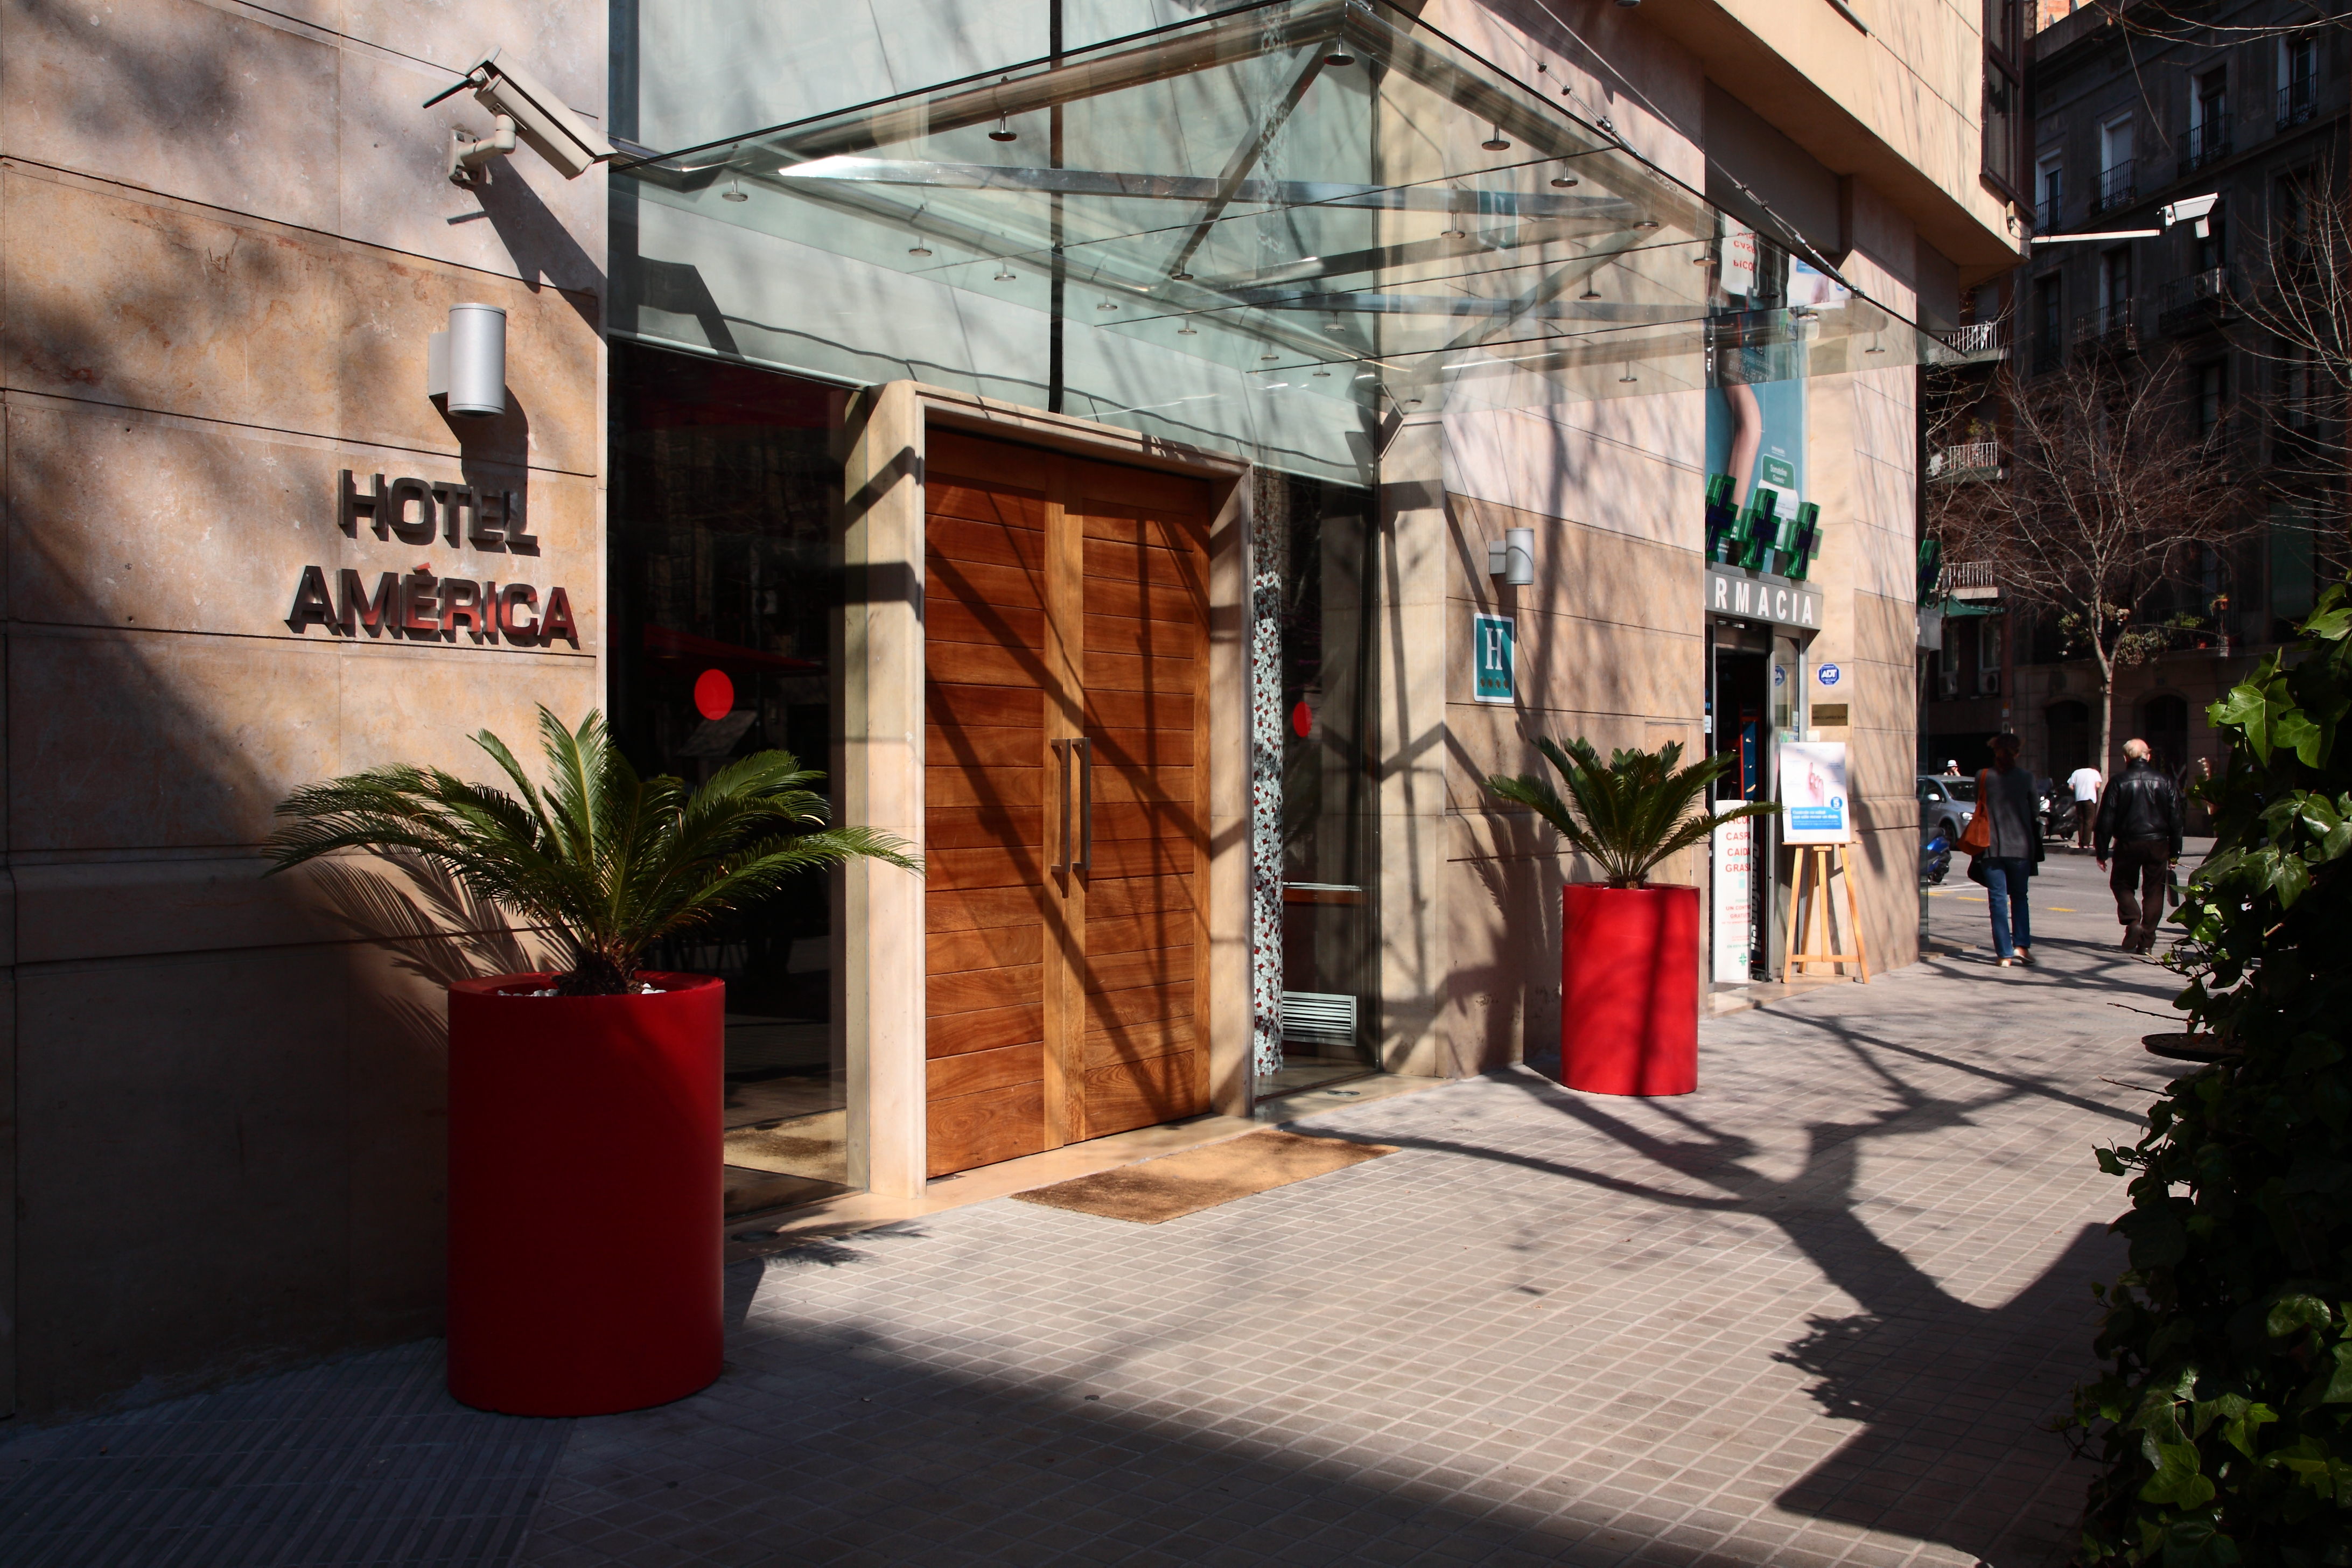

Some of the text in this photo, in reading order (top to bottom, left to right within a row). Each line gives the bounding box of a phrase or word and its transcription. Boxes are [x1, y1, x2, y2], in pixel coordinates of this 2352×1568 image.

[339, 469, 540, 547] HOTEL
[287, 563, 579, 642] AMÉRICA
[1705, 577, 1813, 625] RMACIA
[1485, 627, 1503, 670] H
[1821, 669, 1837, 678] ADT
[1726, 832, 1751, 841] CASPA
[1725, 863, 1751, 872] GRASA
